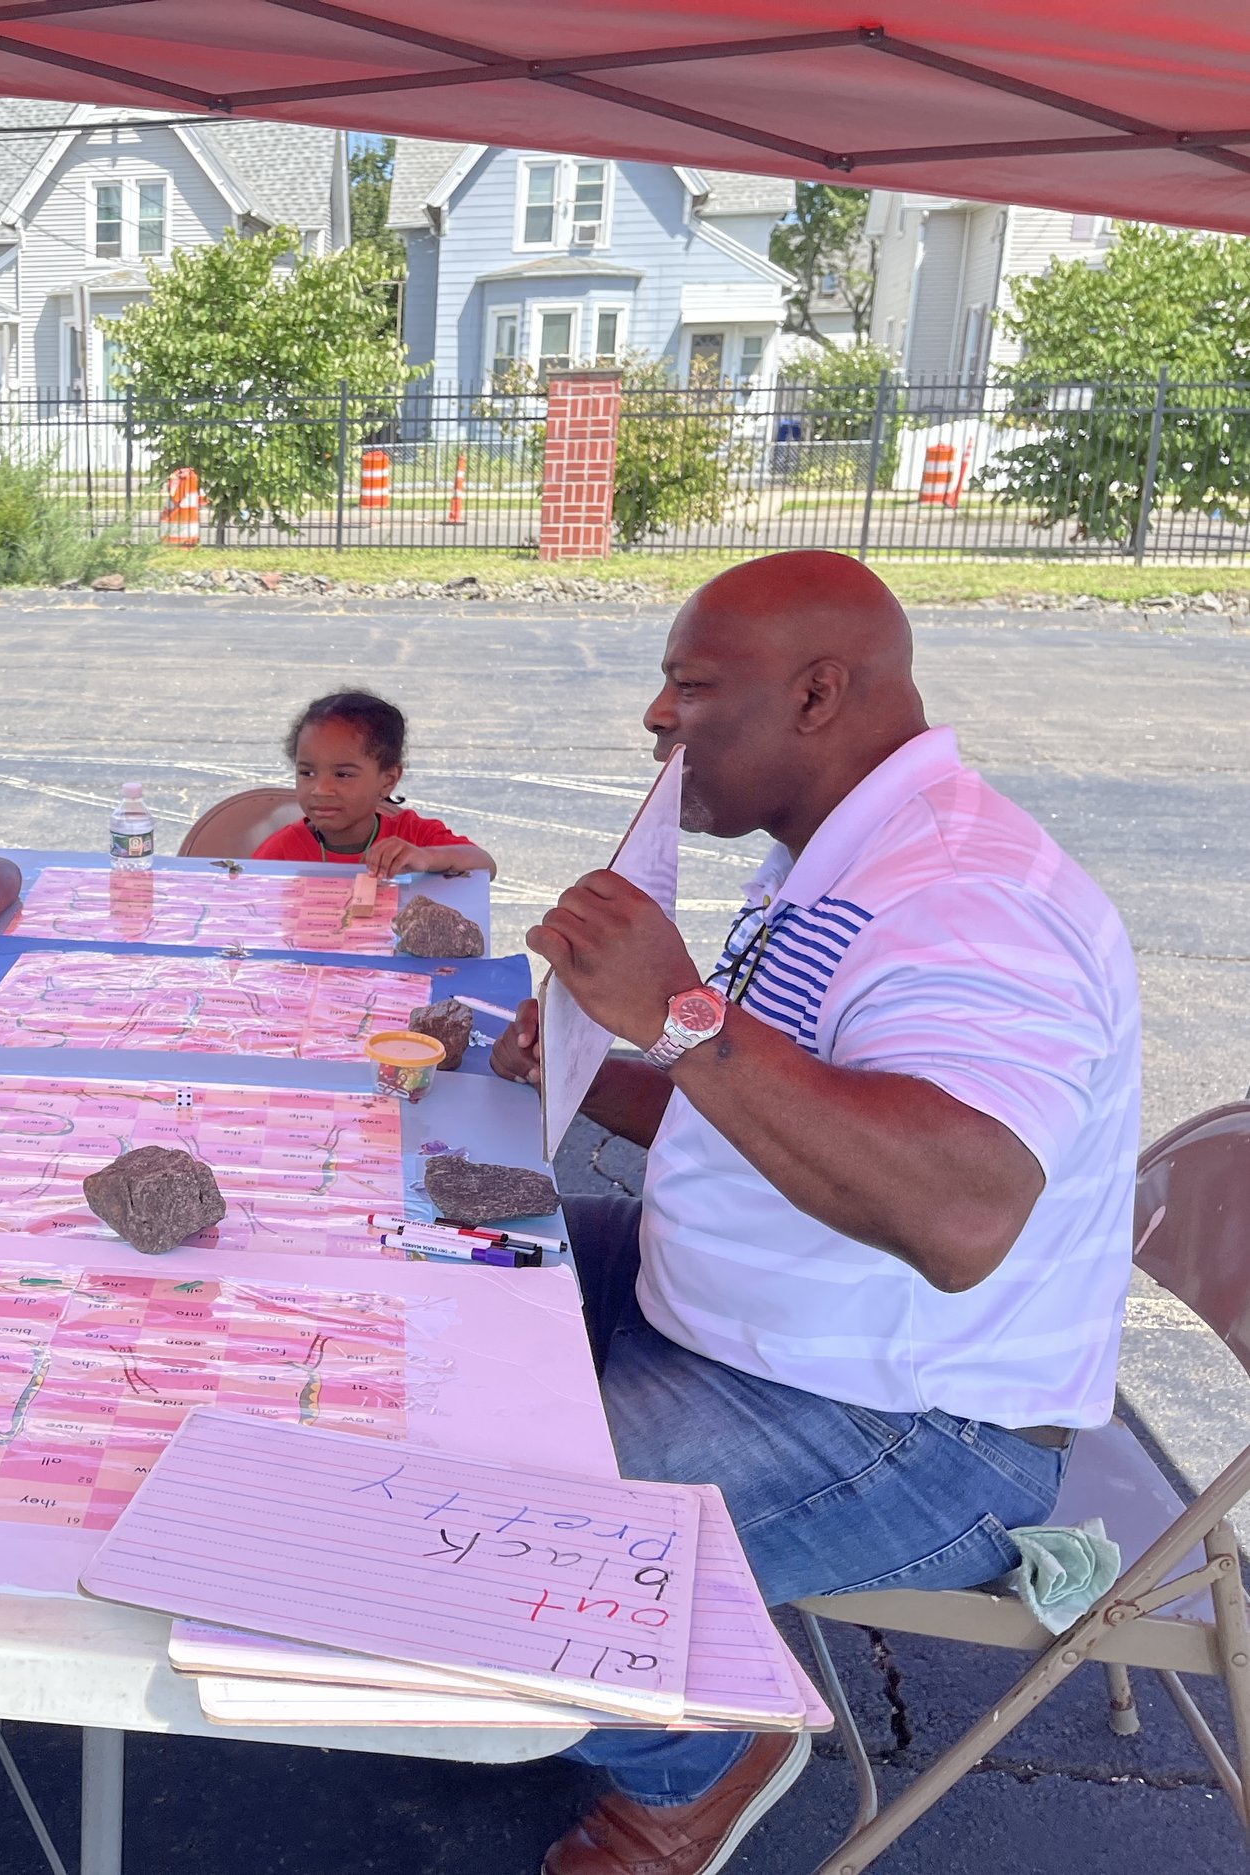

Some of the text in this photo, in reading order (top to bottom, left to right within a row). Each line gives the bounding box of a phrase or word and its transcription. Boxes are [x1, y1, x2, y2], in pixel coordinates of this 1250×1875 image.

[13, 1296, 37, 1306] did
[254, 1346, 287, 1357] four
[342, 1416, 374, 1425] now
[45, 1422, 84, 1433] have
[41, 1456, 62, 1466] all
[19, 1495, 57, 1508] they
[508, 1589, 670, 1628] out
[550, 1639, 658, 1680] all
